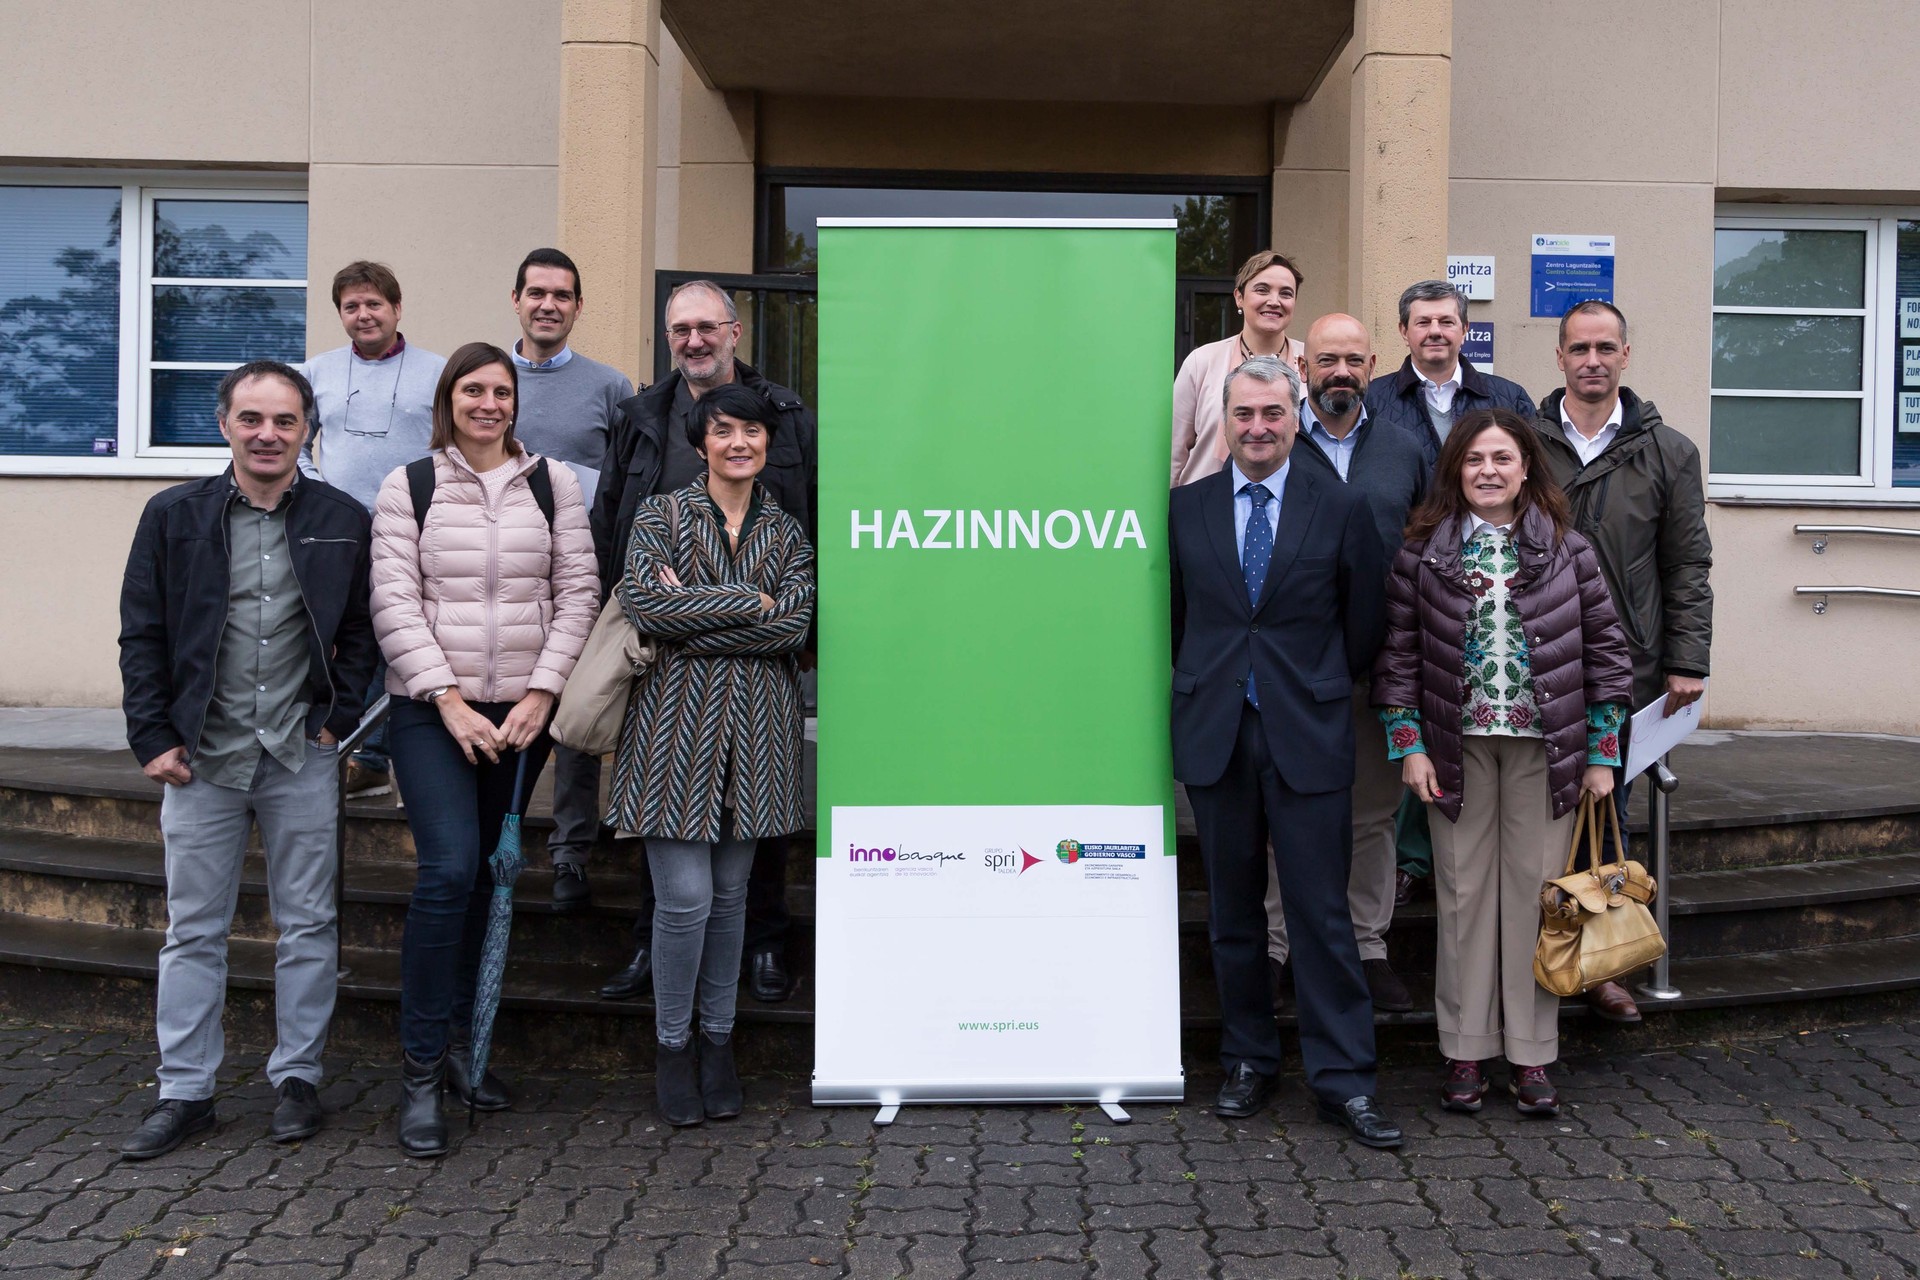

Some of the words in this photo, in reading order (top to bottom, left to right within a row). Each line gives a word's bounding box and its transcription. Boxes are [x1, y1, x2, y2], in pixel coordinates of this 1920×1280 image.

[1447, 261, 1492, 279] gintza
[1456, 280, 1472, 294] rri
[1906, 318, 1920, 329] NO
[1906, 367, 1920, 376] ZUR
[850, 508, 1148, 550] HAZINNOVA
[850, 843, 966, 868] innobasque
[984, 851, 1014, 871] spri
[958, 1020, 1039, 1032] www.spri.eus
